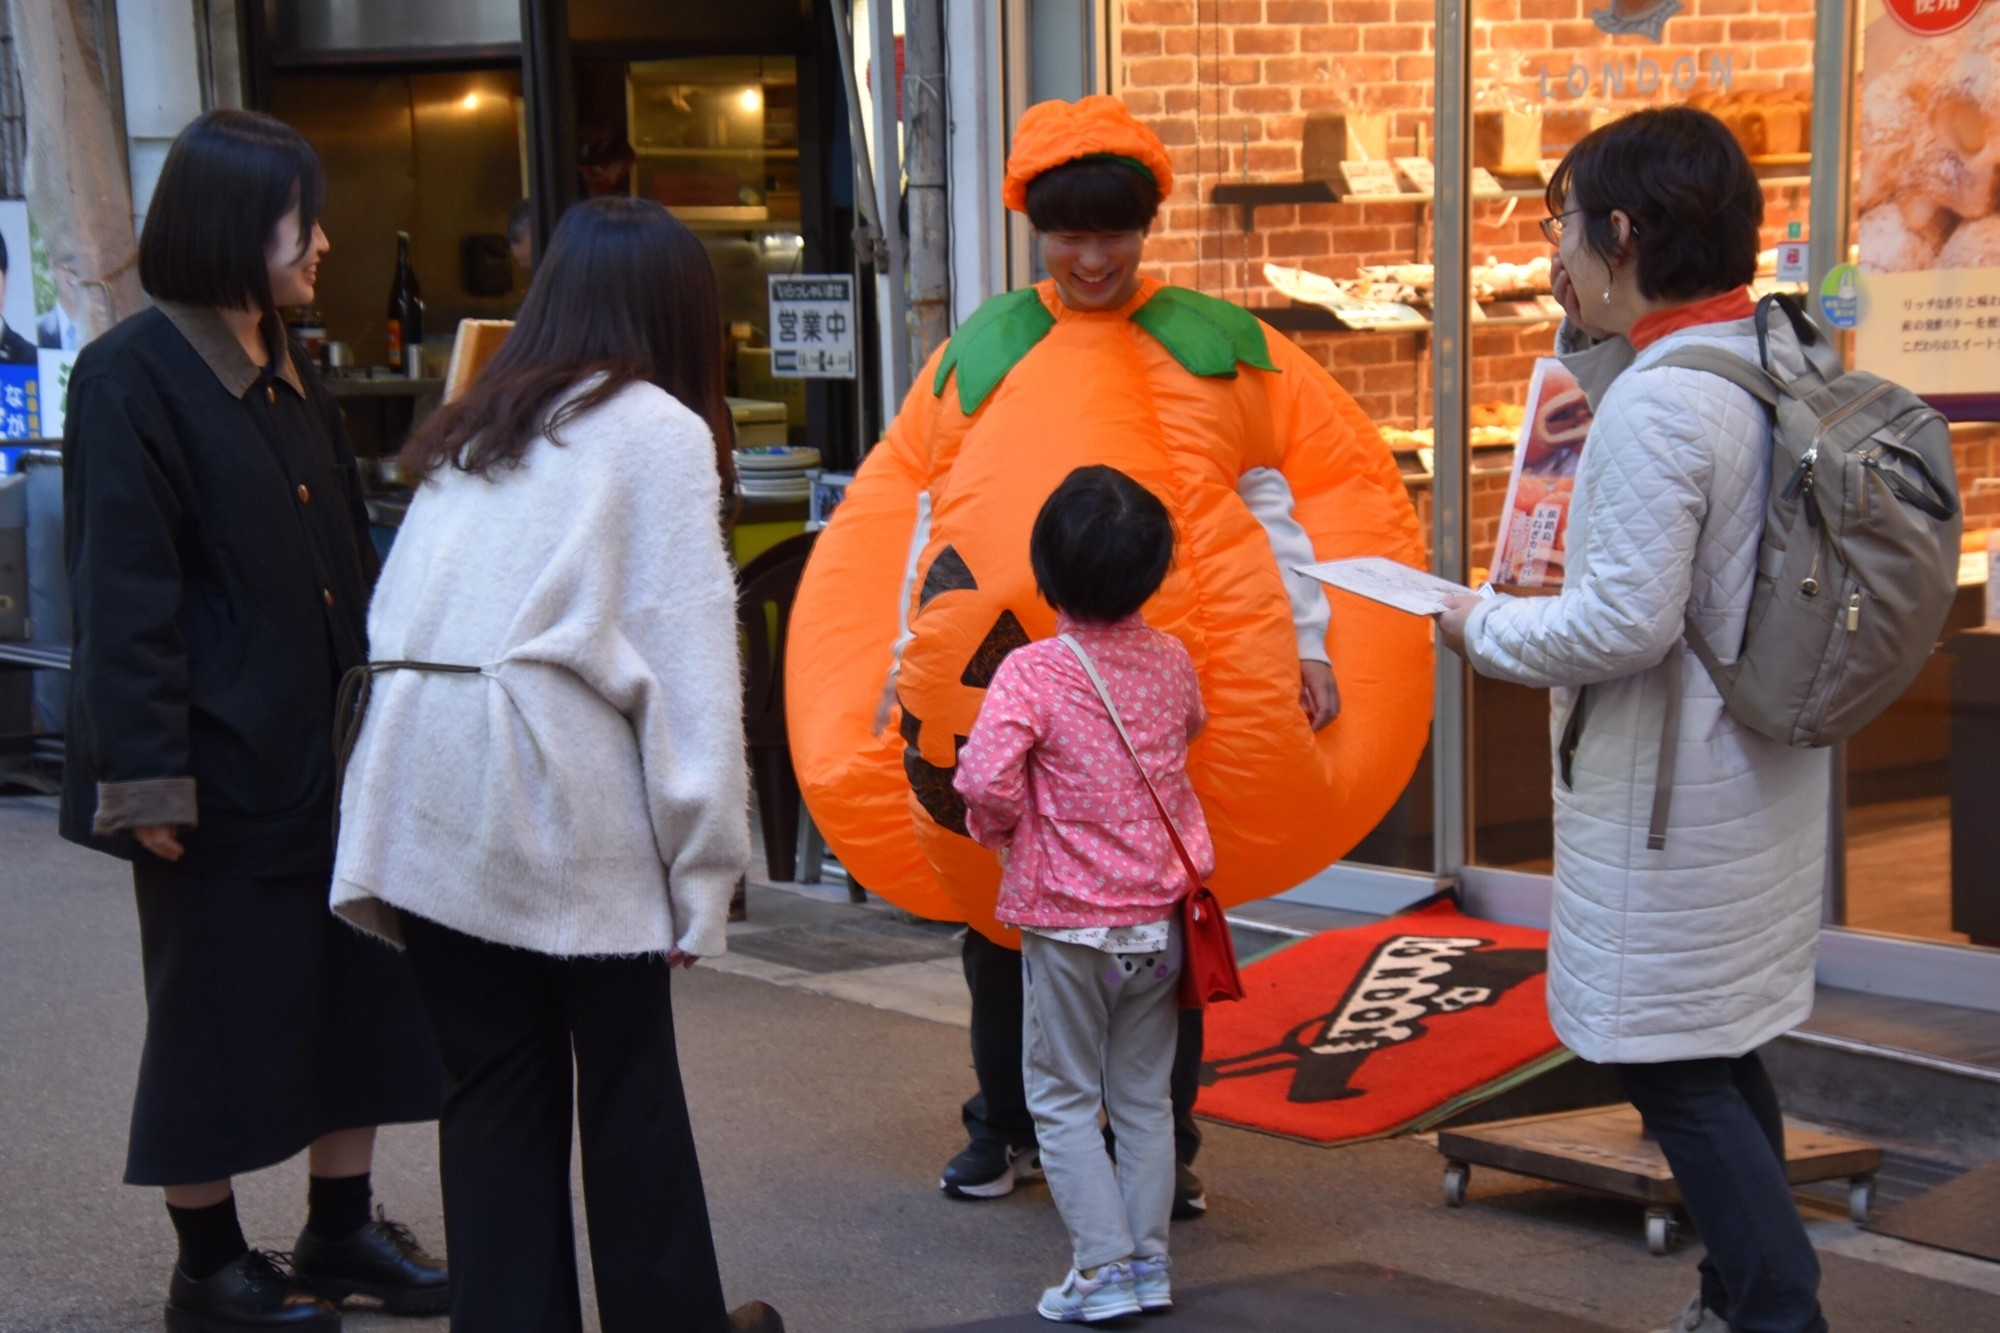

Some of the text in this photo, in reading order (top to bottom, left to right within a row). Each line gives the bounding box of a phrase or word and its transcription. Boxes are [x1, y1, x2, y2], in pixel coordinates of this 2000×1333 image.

[1540, 53, 1734, 98] LONDON
[777, 283, 844, 299] いらっしゃいませ
[777, 309, 846, 342] 営業中
